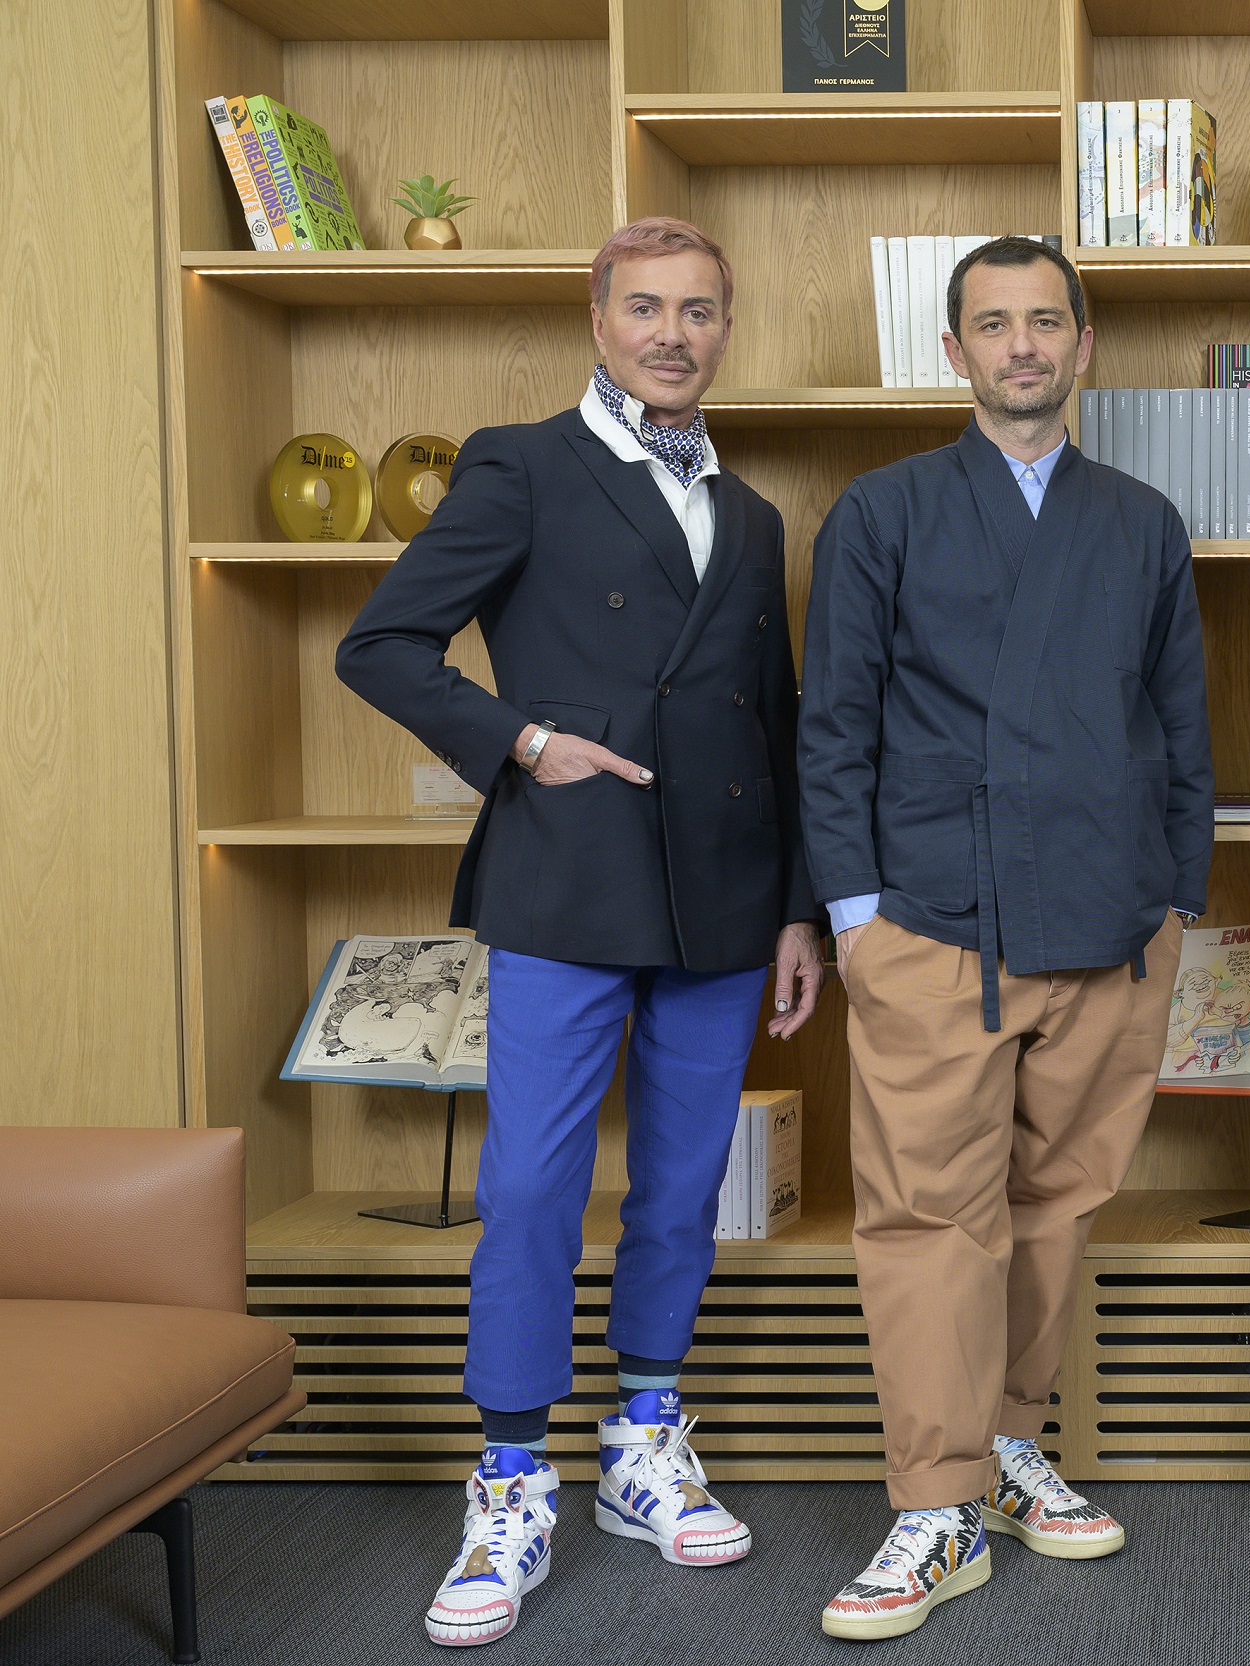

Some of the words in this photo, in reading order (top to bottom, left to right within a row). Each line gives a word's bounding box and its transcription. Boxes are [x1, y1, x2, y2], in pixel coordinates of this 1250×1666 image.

[849, 14, 886, 22] ΑΡΙΣΤΕΙΟ
[220, 132, 237, 144] THE
[239, 130, 257, 144] THE
[259, 128, 277, 142] THE
[223, 142, 258, 204] HISTORY
[262, 140, 298, 207] POLITICS
[243, 141, 284, 221] RELIGIONS
[302, 173, 341, 205] POLITICS
[244, 204, 261, 215] BOOK
[284, 203, 301, 214] BOOK
[271, 217, 288, 228] BOOK
[659, 1407, 679, 1415] adidas
